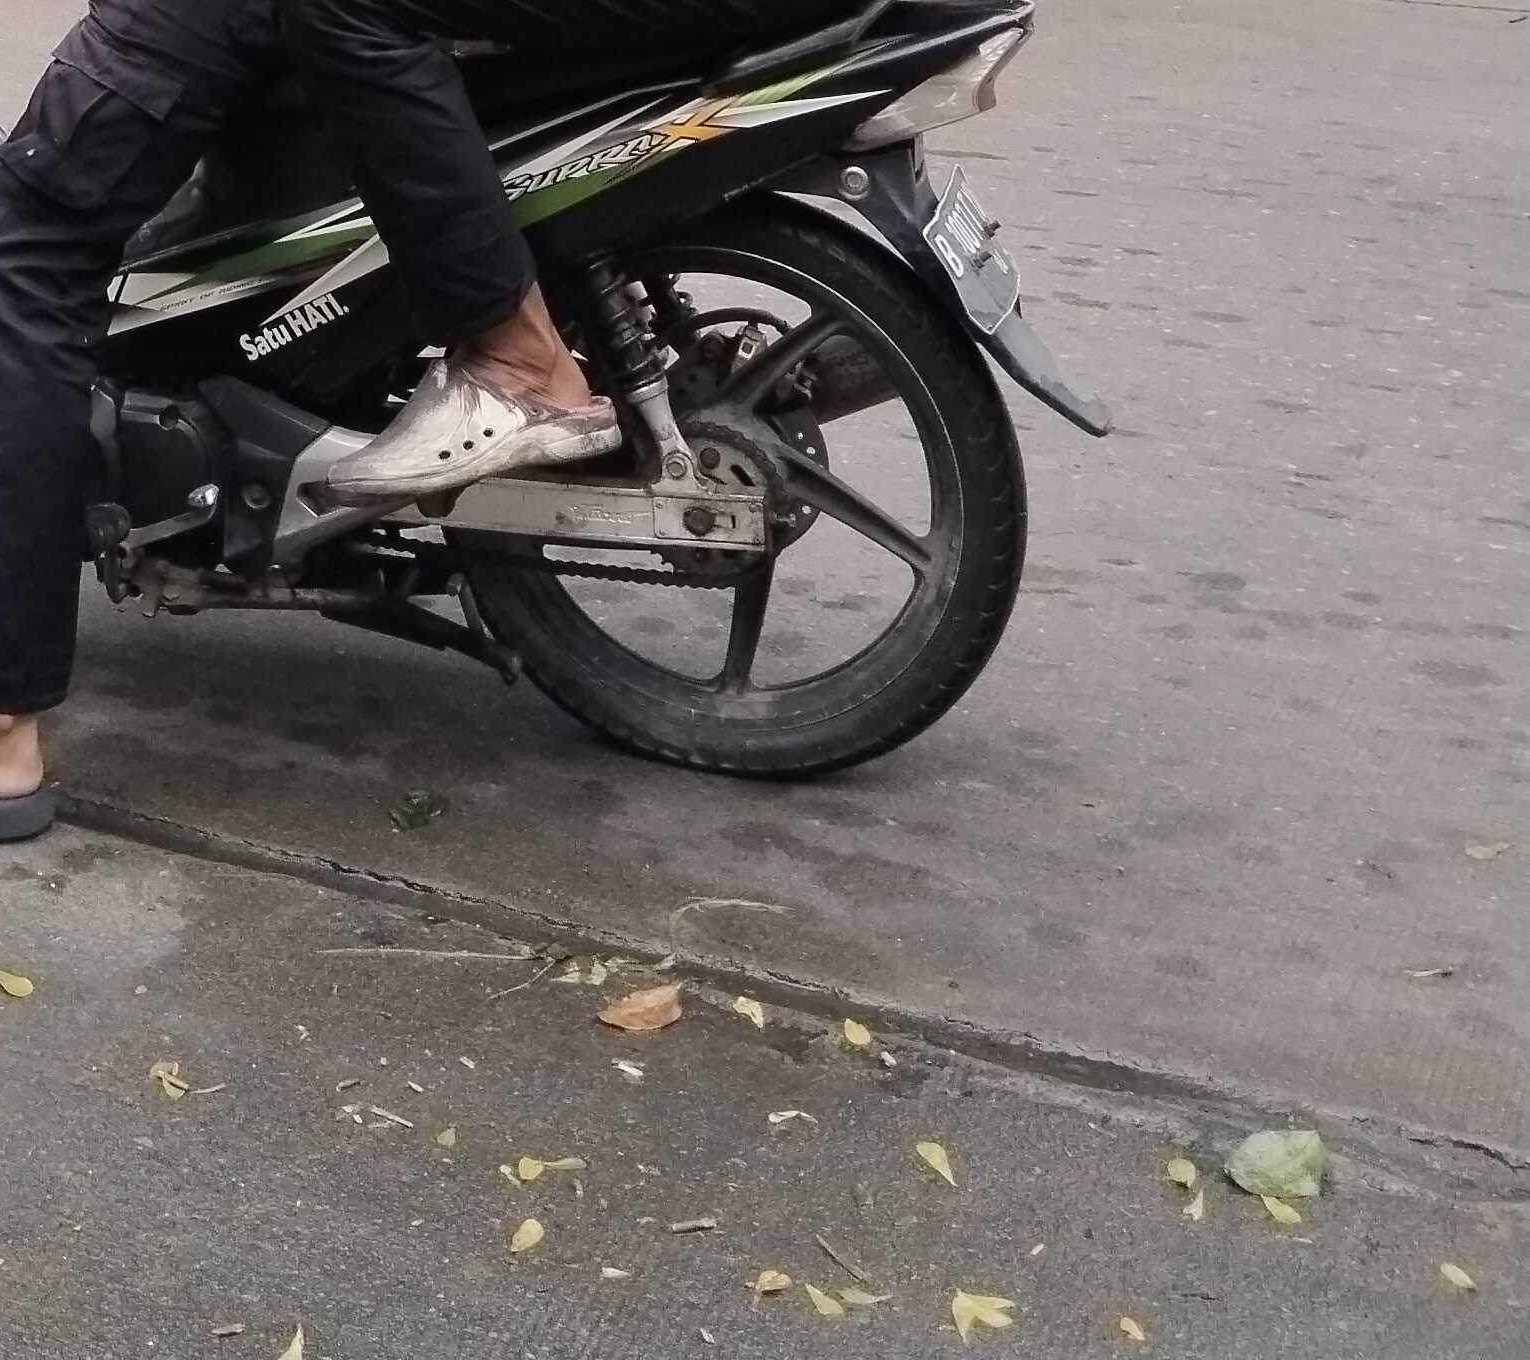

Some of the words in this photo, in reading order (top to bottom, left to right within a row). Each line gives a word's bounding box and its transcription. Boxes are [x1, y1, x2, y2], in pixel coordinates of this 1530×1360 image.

[503, 132, 665, 201] SUPRA
[239, 323, 292, 361] Satu
[285, 293, 350, 338] HATI.
